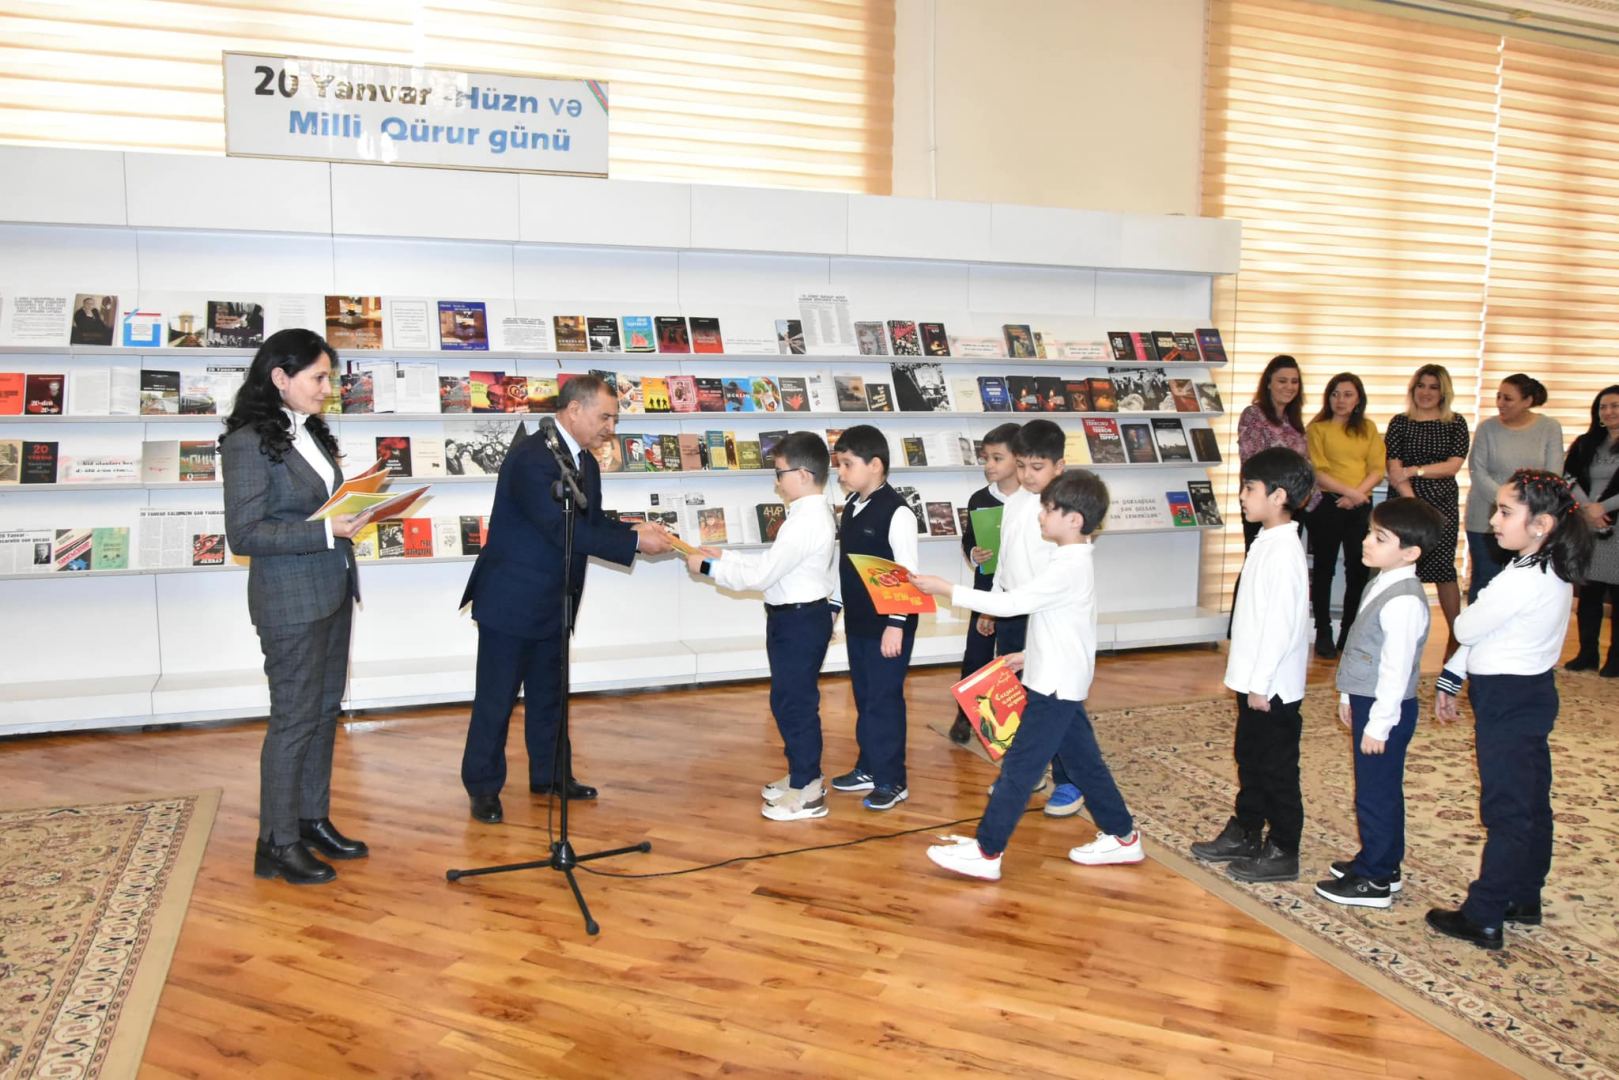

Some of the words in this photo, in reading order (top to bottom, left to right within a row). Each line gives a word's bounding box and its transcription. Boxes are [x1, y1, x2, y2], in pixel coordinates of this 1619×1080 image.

[254, 65, 299, 98] 20
[311, 74, 432, 106] Yanvar
[549, 97, 582, 118] və
[289, 110, 361, 138] Milli
[381, 116, 480, 146] Qürur
[488, 125, 571, 154] günü
[33, 444, 49, 455] 20
